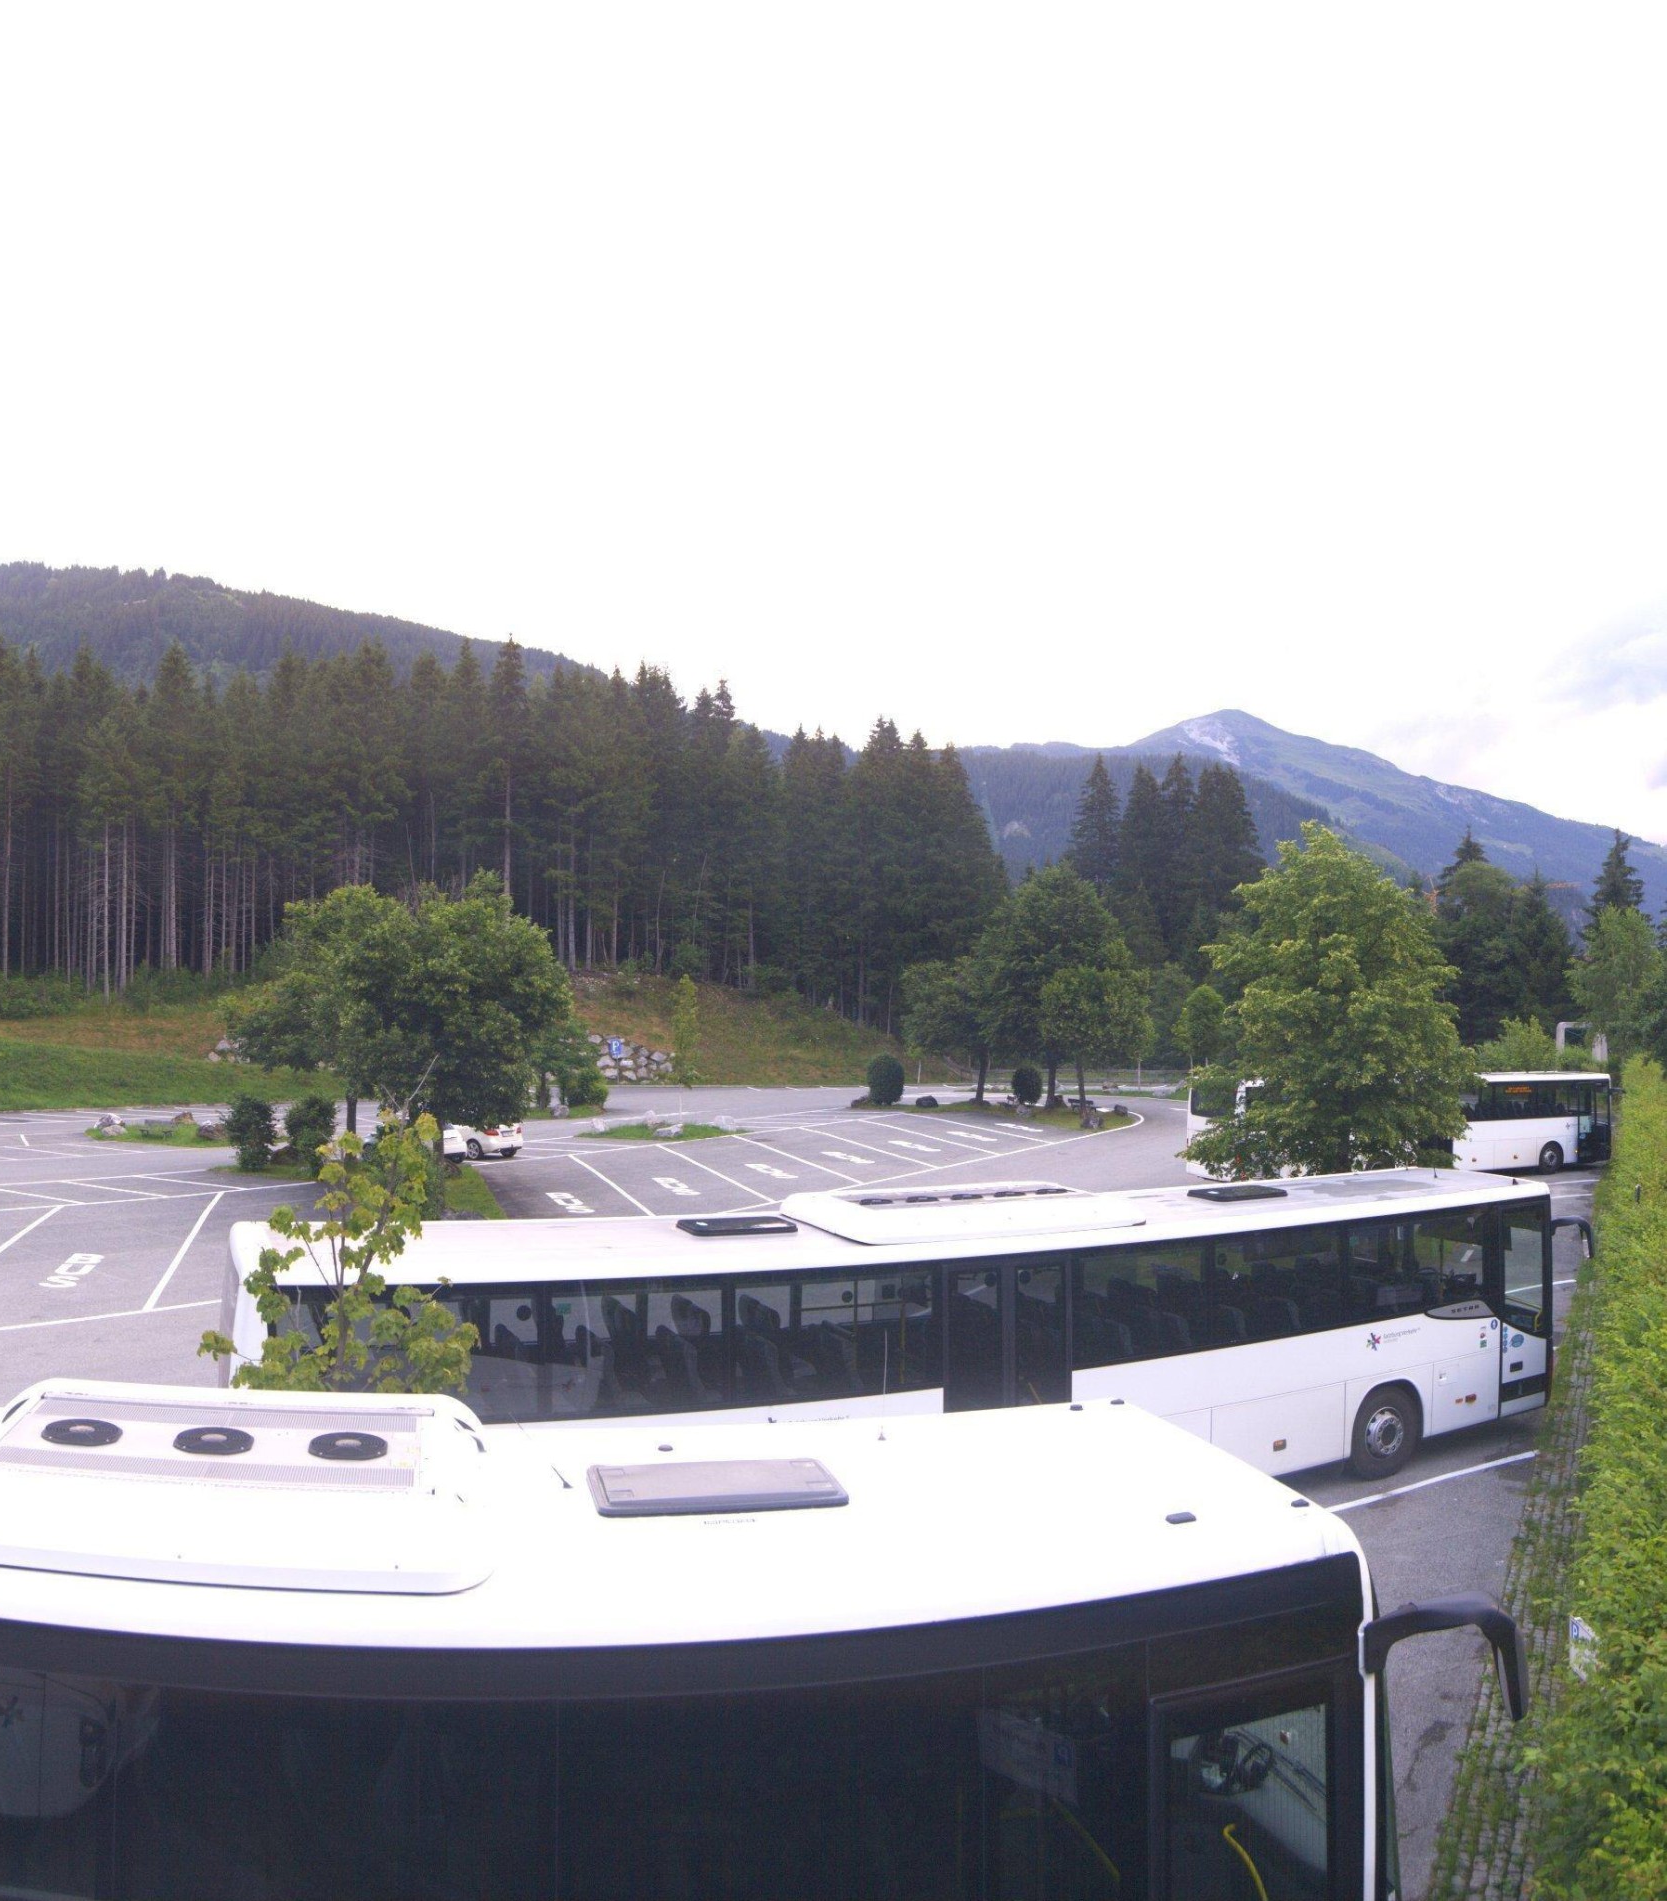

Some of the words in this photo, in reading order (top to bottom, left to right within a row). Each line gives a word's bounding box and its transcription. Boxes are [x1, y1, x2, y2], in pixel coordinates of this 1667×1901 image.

[612, 1041, 620, 1052] P
[652, 1177, 702, 1196] BUS
[545, 1192, 595, 1213] BUS
[38, 1252, 105, 1288] BUS
